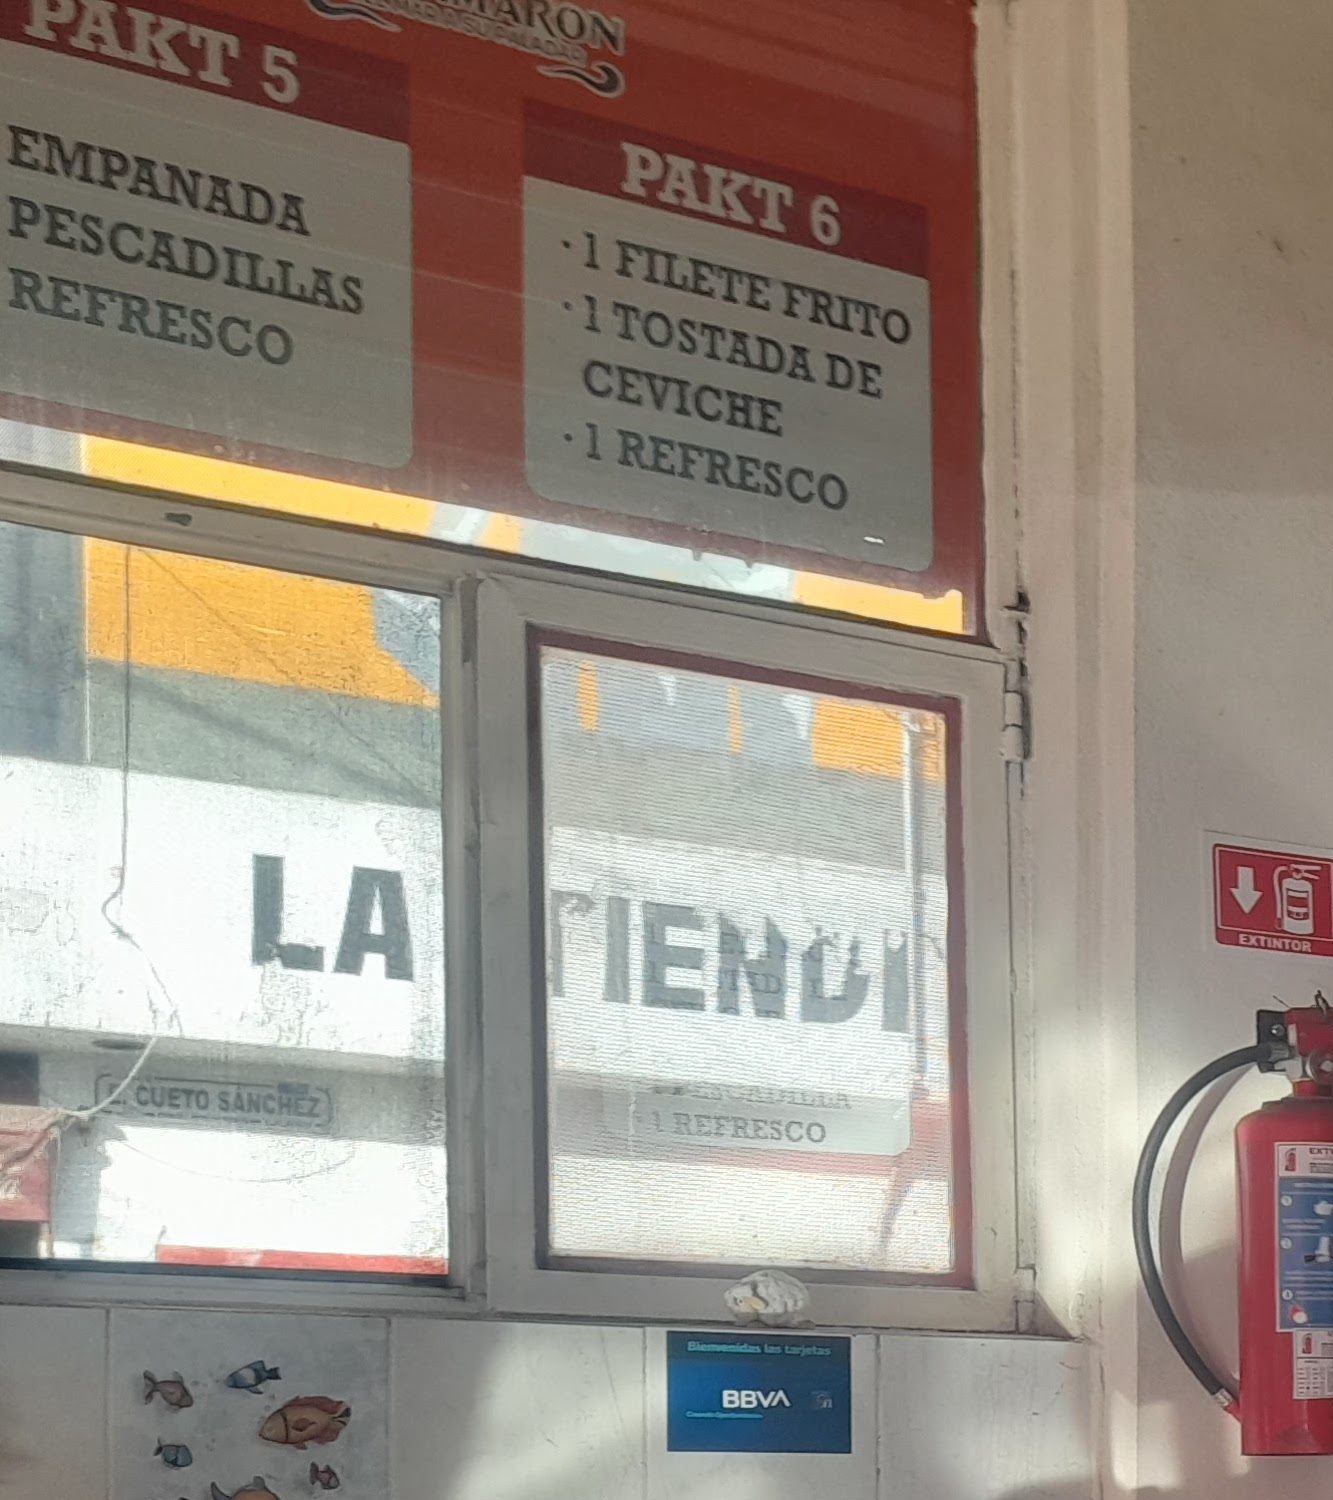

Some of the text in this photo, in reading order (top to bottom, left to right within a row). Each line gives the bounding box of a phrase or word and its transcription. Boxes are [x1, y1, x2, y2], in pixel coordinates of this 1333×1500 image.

[23, 0, 241, 88] PAKT
[260, 44, 301, 104] 5
[7, 123, 311, 238] EMPANADA
[619, 141, 842, 248] PAKT 6
[7, 194, 366, 316] PESCADILLAS
[582, 230, 913, 347] 1 FILETE FRITO
[7, 265, 295, 366] REFRESCO
[583, 293, 884, 401] 1 TOSTADA DE
[582, 359, 786, 438] CEVICHE
[585, 421, 850, 513] 1 REFRESCO
[251, 852, 416, 983] LA
[1238, 932, 1312, 953] EXTINTOR
[135, 1084, 211, 1112] CUETO
[672, 1112, 828, 1144] REFRESCO
[722, 1388, 792, 1409] BBVA
